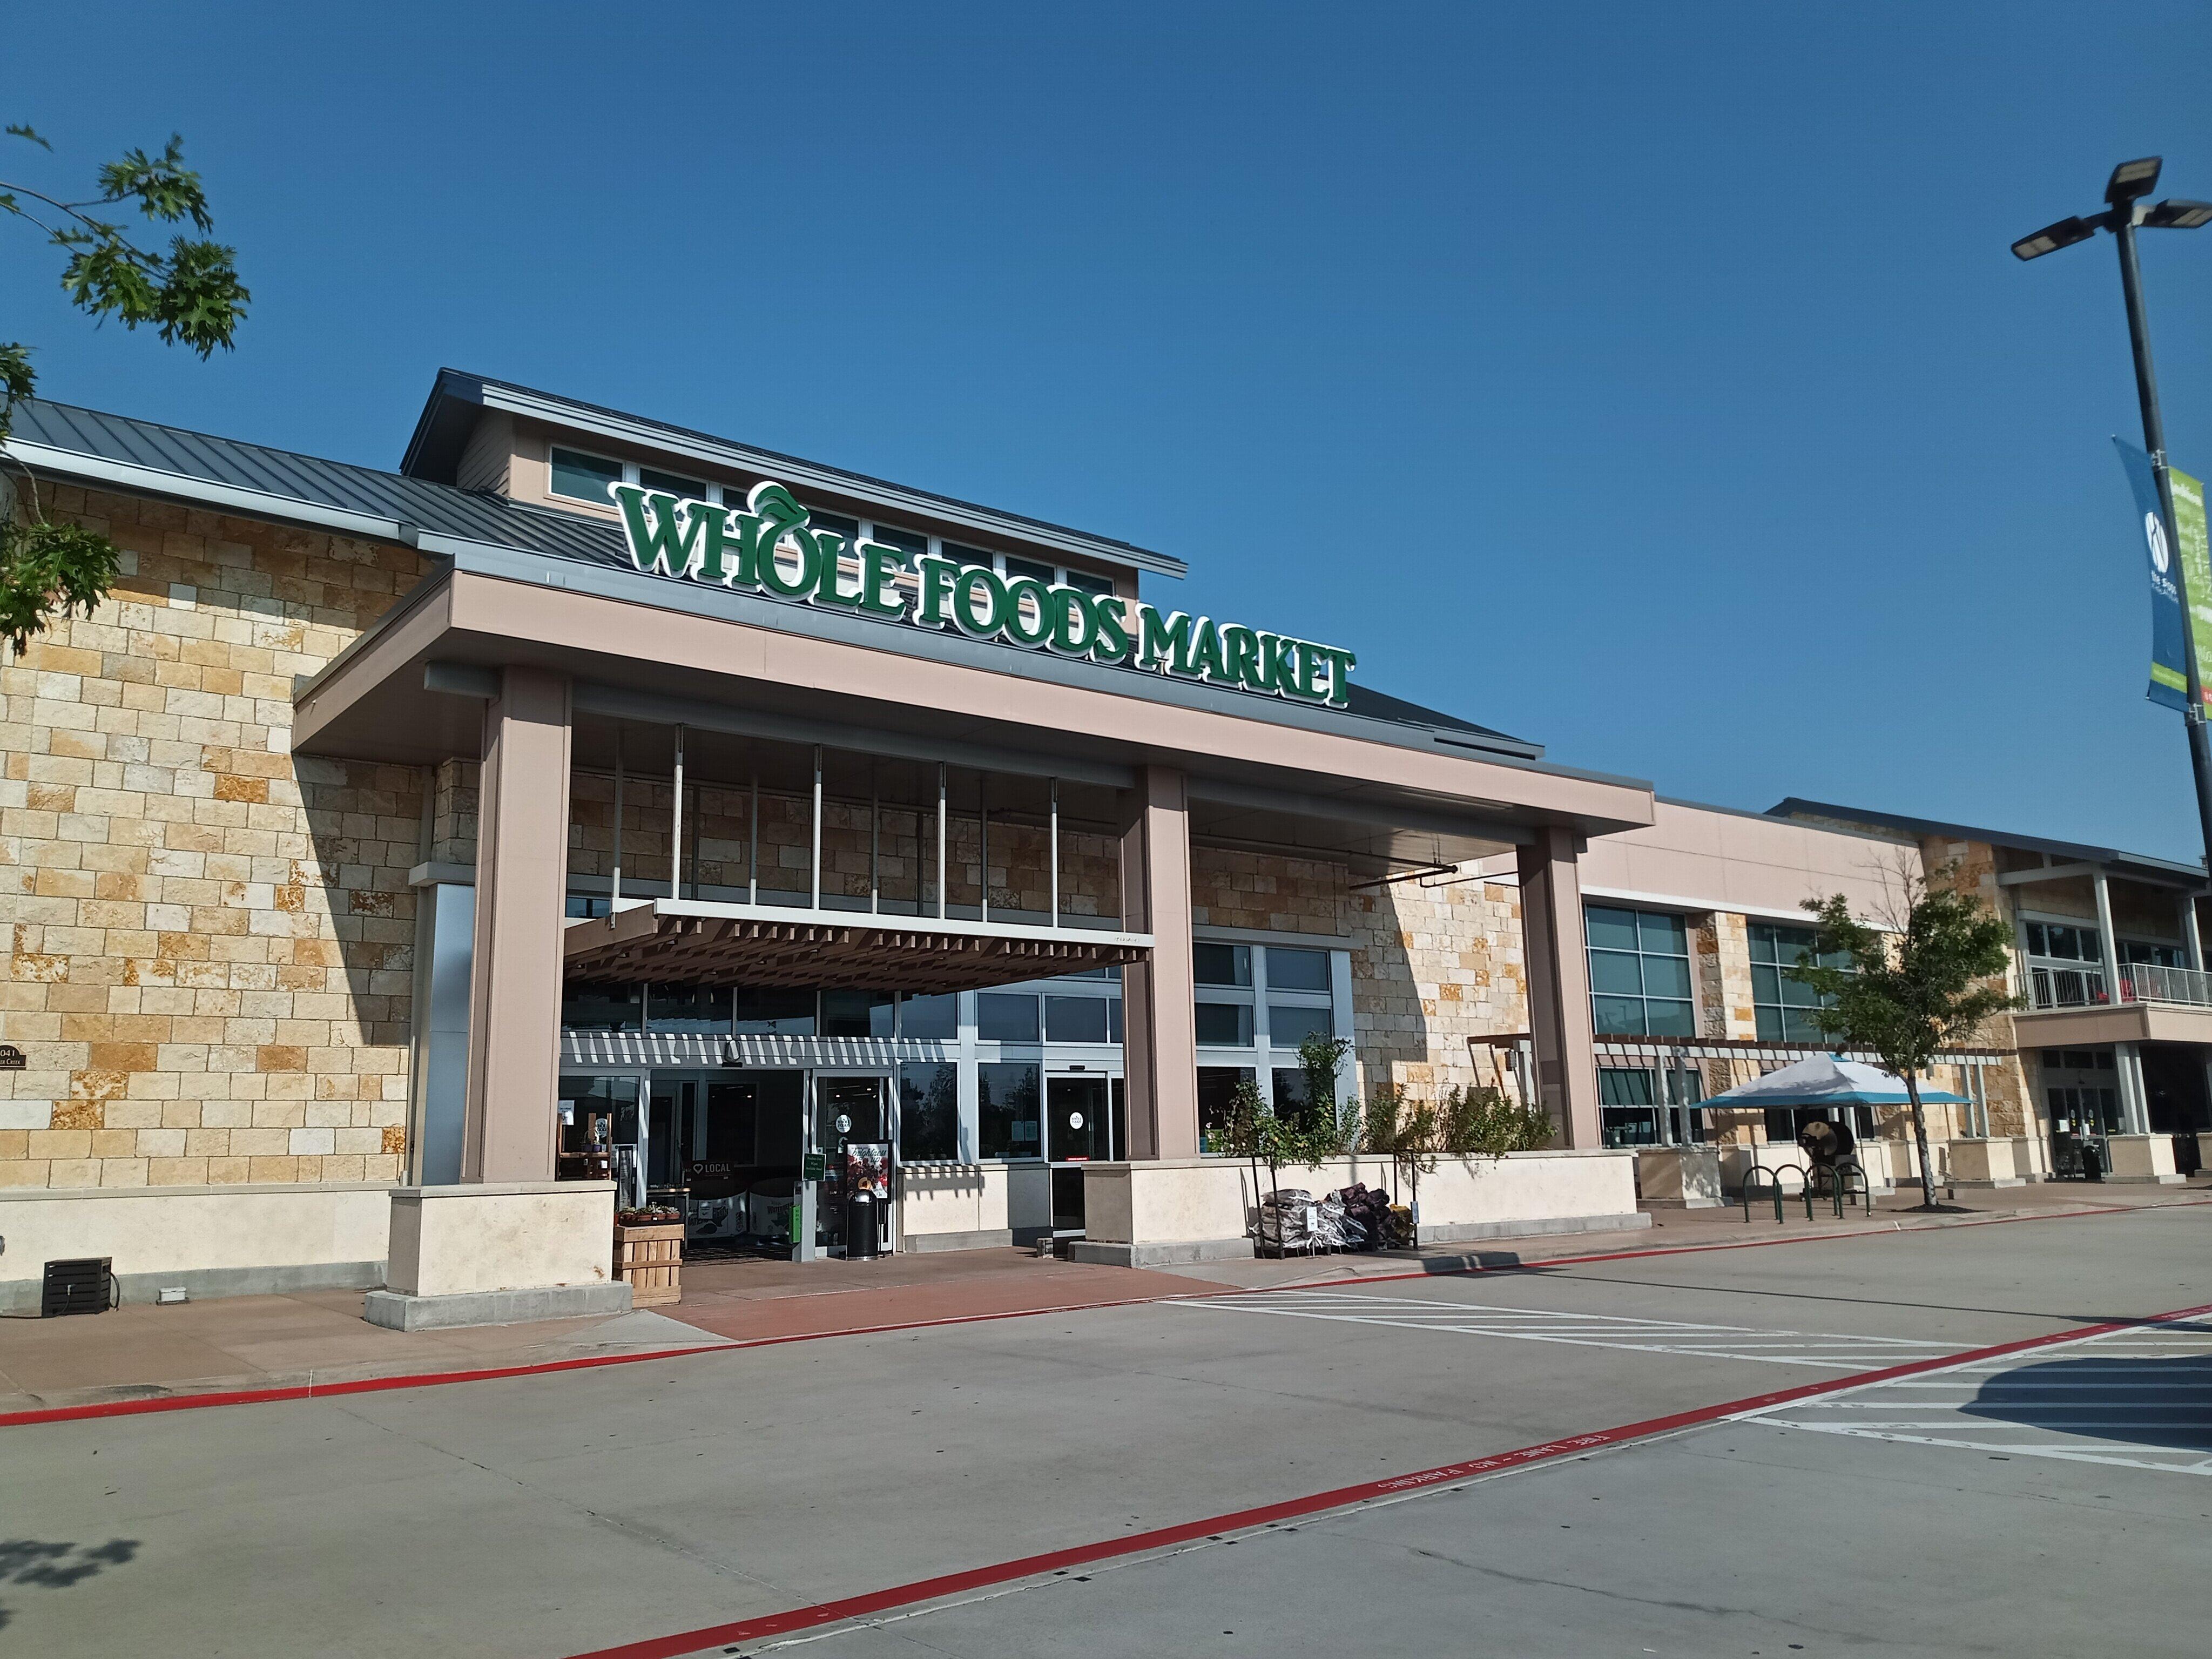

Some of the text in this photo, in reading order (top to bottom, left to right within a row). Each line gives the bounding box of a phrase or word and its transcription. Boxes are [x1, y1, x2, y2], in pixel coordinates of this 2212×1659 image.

[606, 481, 1357, 709] WHOLE FOODS MARKET
[705, 1163, 731, 1173] LOCAL
[1567, 1435, 1610, 1446] FIRE
[1514, 1444, 1567, 1458] LANE
[1468, 1460, 1501, 1469] NO
[1378, 1468, 1464, 1489] PARKING
